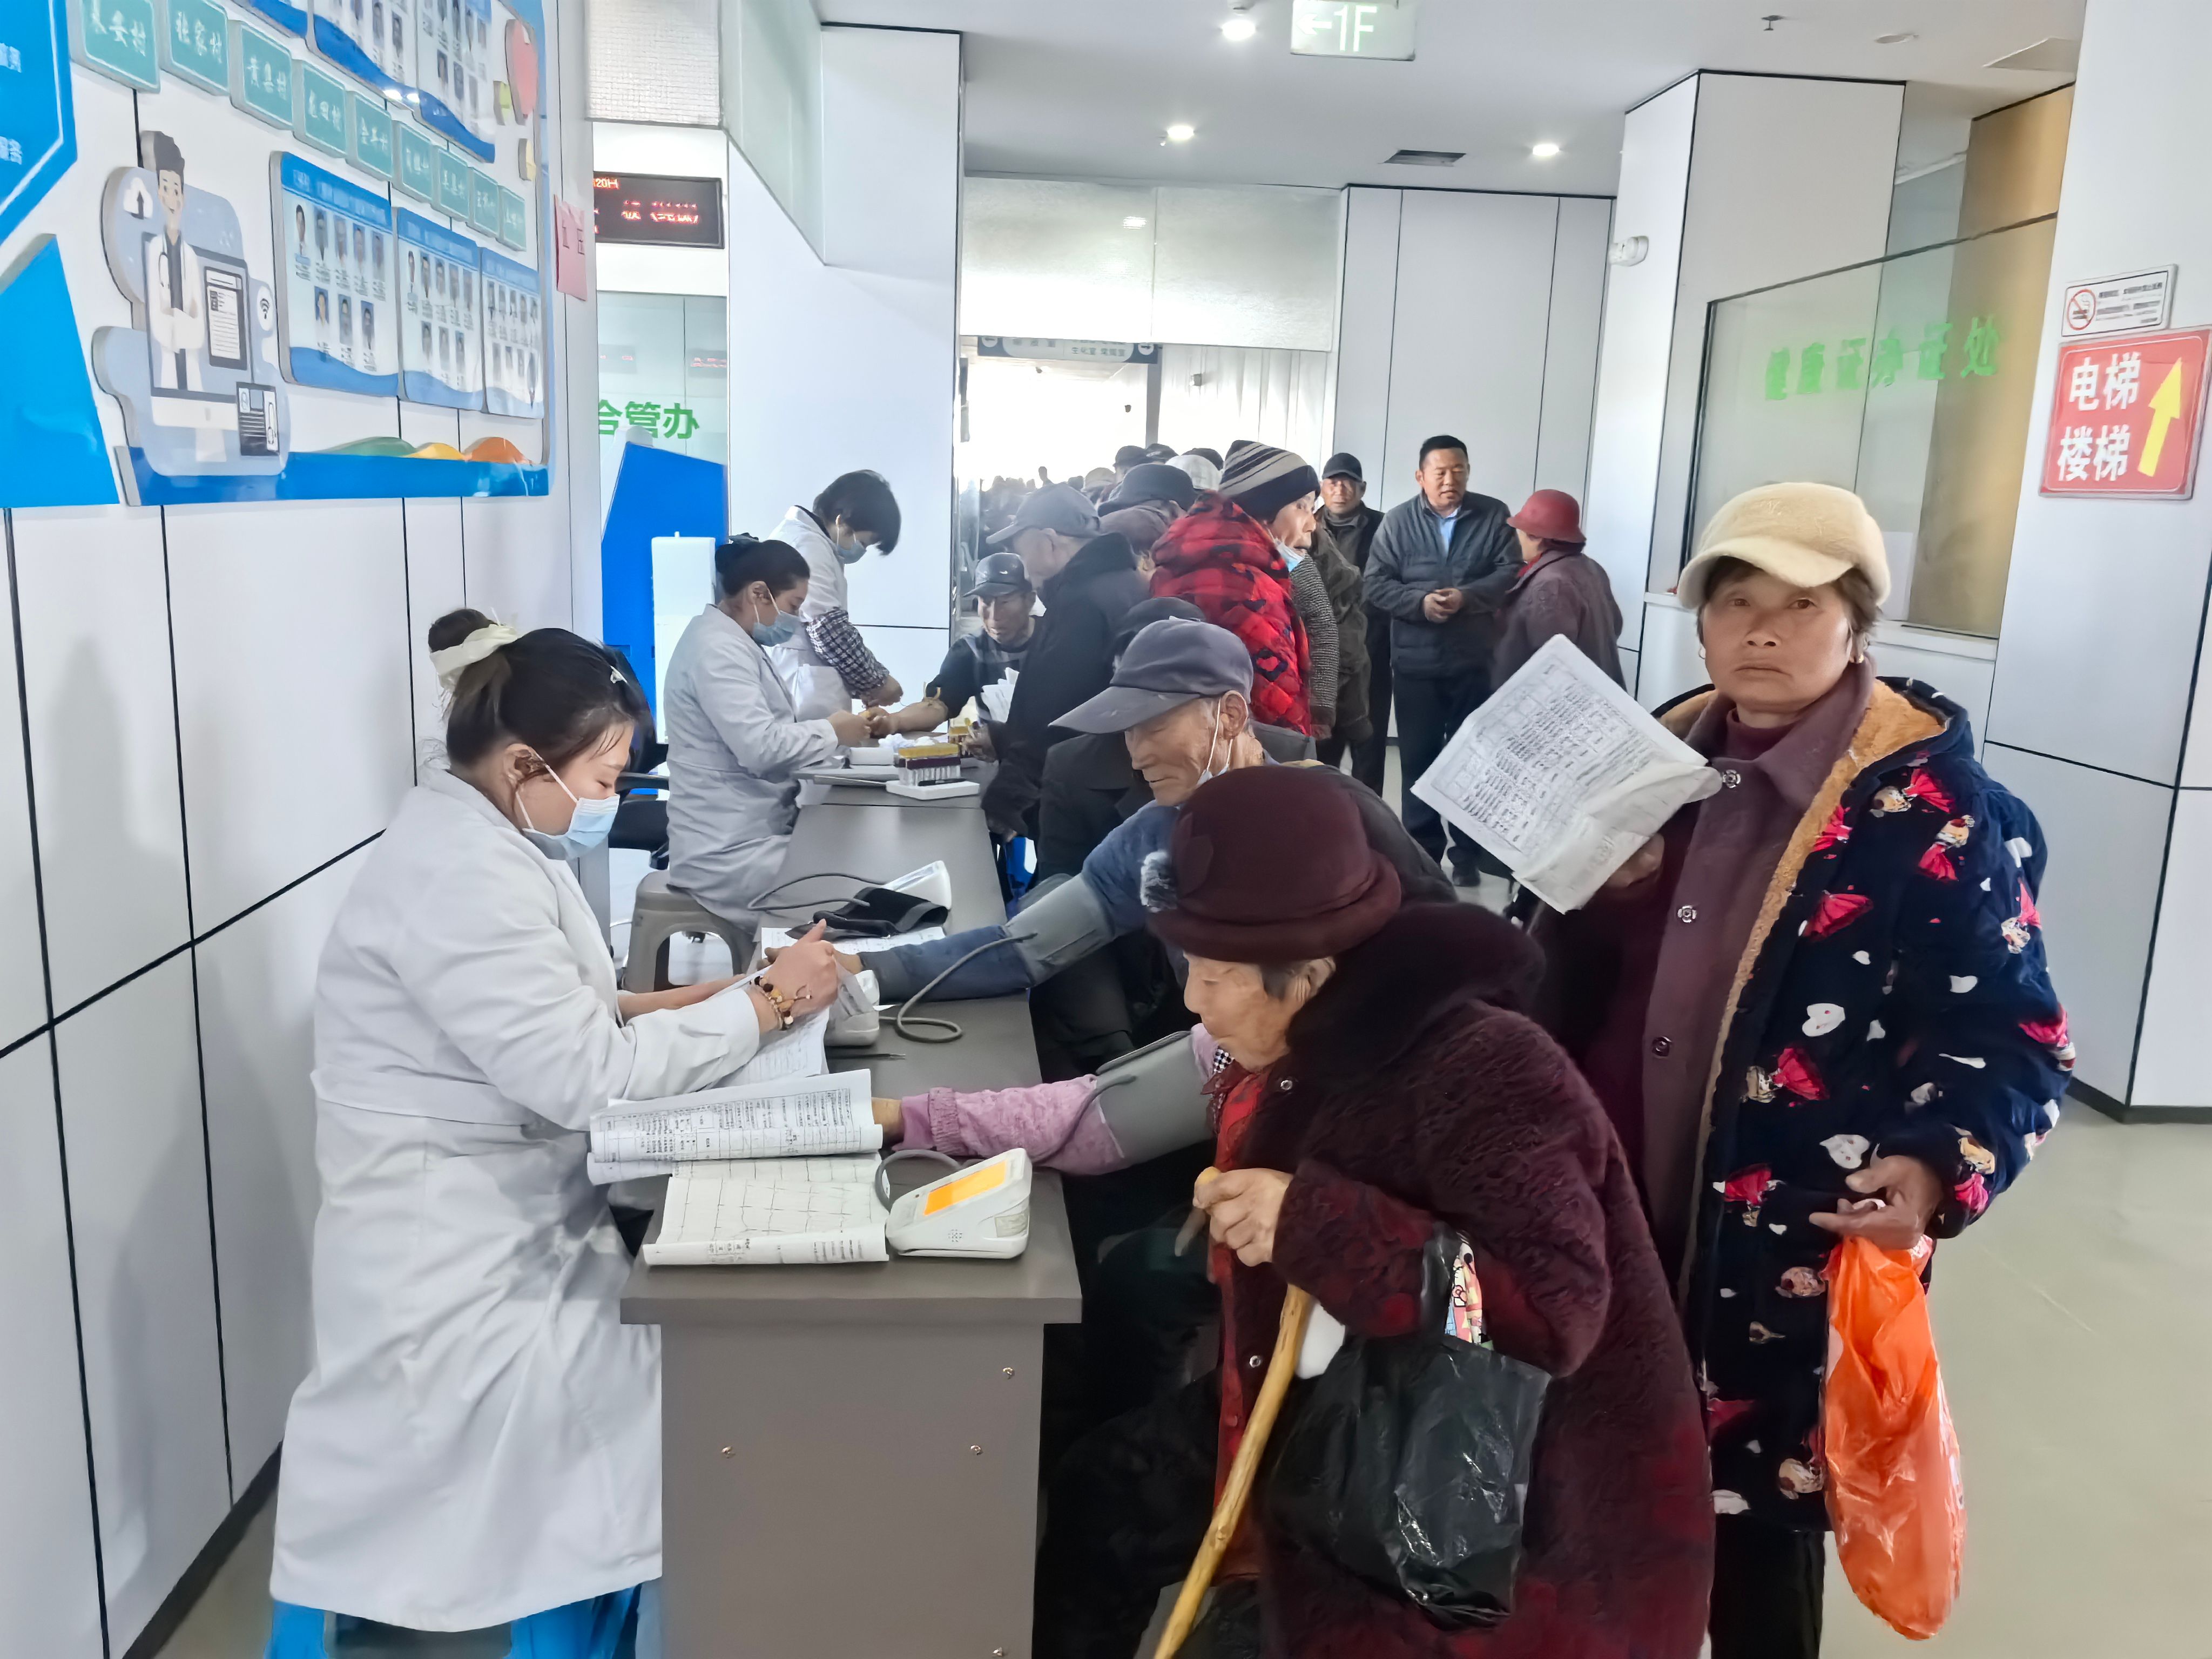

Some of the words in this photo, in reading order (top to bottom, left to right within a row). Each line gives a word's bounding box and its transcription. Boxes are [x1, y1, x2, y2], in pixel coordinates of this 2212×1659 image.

[1333, 4, 1378, 52] 1F
[2068, 352, 2142, 411] 电梯
[598, 399, 700, 439] 合管办
[2056, 424, 2131, 482] 楼梯
